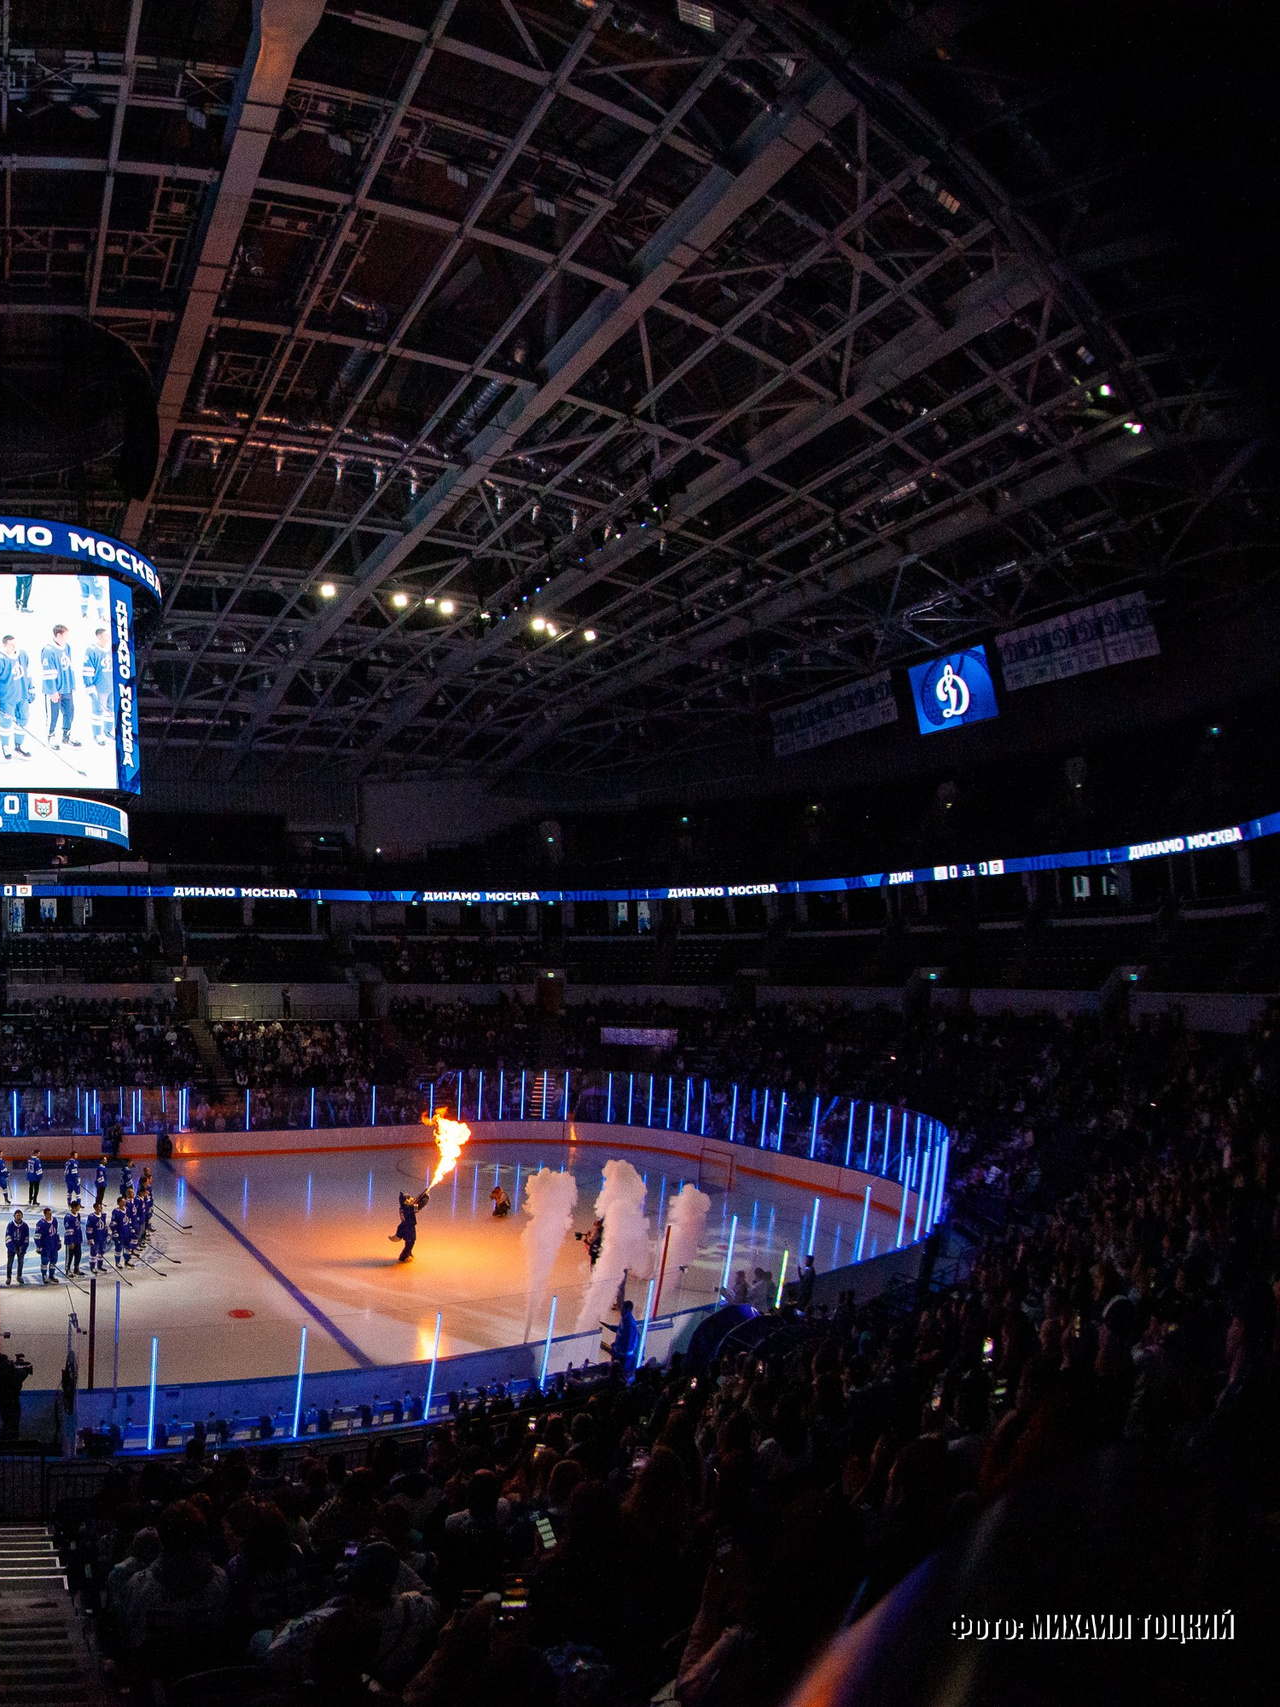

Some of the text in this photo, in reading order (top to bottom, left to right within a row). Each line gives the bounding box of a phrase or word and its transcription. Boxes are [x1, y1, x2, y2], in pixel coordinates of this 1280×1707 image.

[68, 532, 161, 599] МОСКВА
[115, 600, 134, 768] ДИНАМО МОСКВА
[4, 795, 19, 814] 0
[1129, 827, 1243, 860] ДИНАМО МОСКВА
[889, 872, 913, 884] ДИН
[950, 865, 958, 878] 0
[4, 885, 14, 896] 0
[173, 887, 297, 897] ДИНАМО МОСКВА
[423, 892, 539, 901] ДИНАМО МОСКВА
[668, 884, 778, 898] ДИНАМО МОСКВА
